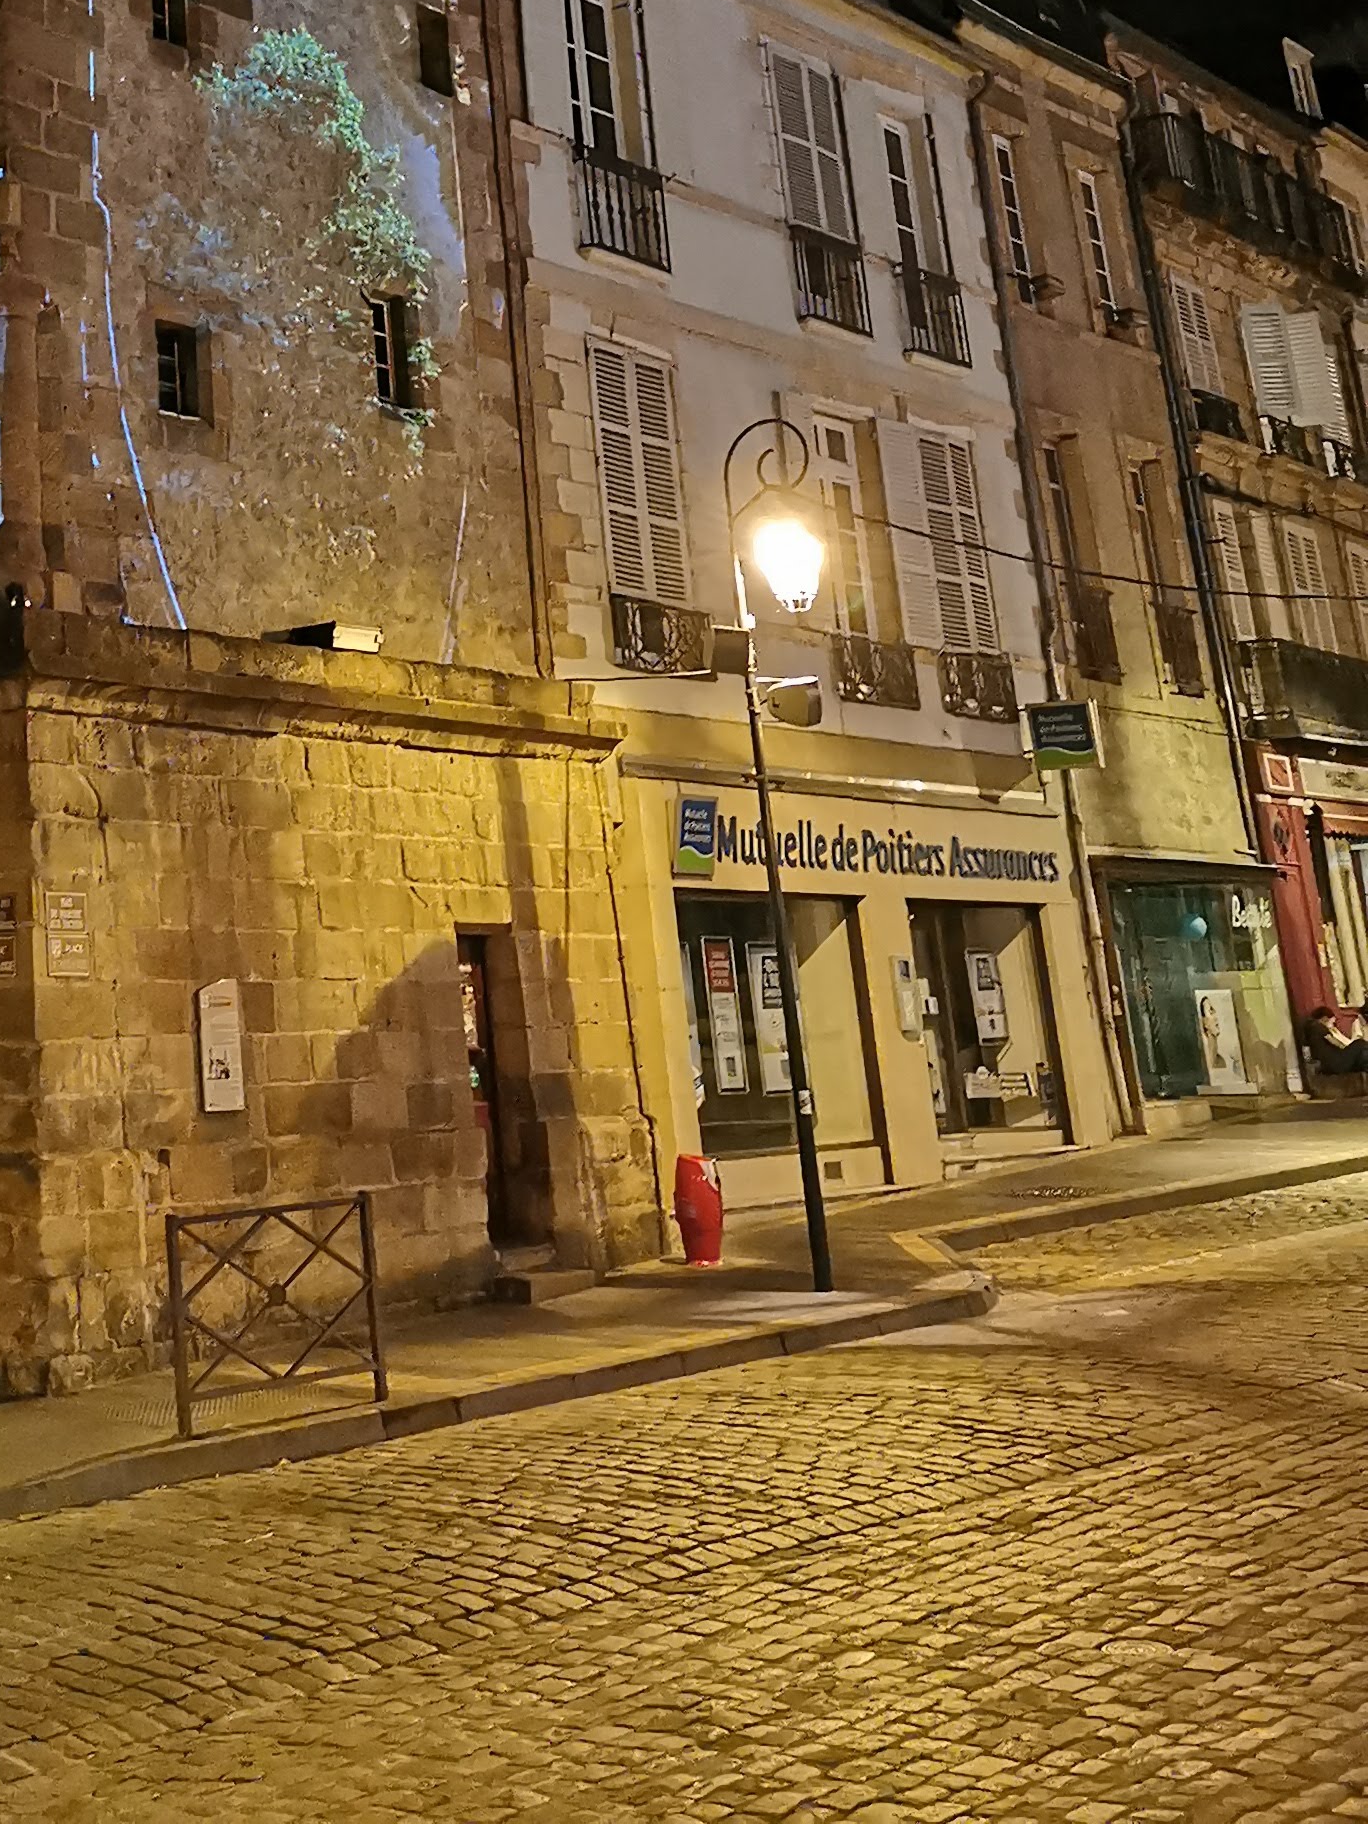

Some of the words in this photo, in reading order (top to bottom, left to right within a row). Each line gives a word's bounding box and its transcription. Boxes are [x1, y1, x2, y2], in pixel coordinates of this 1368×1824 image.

[832, 823, 859, 872] de
[861, 828, 945, 877] Poitiers
[949, 835, 1060, 883] Assurances
